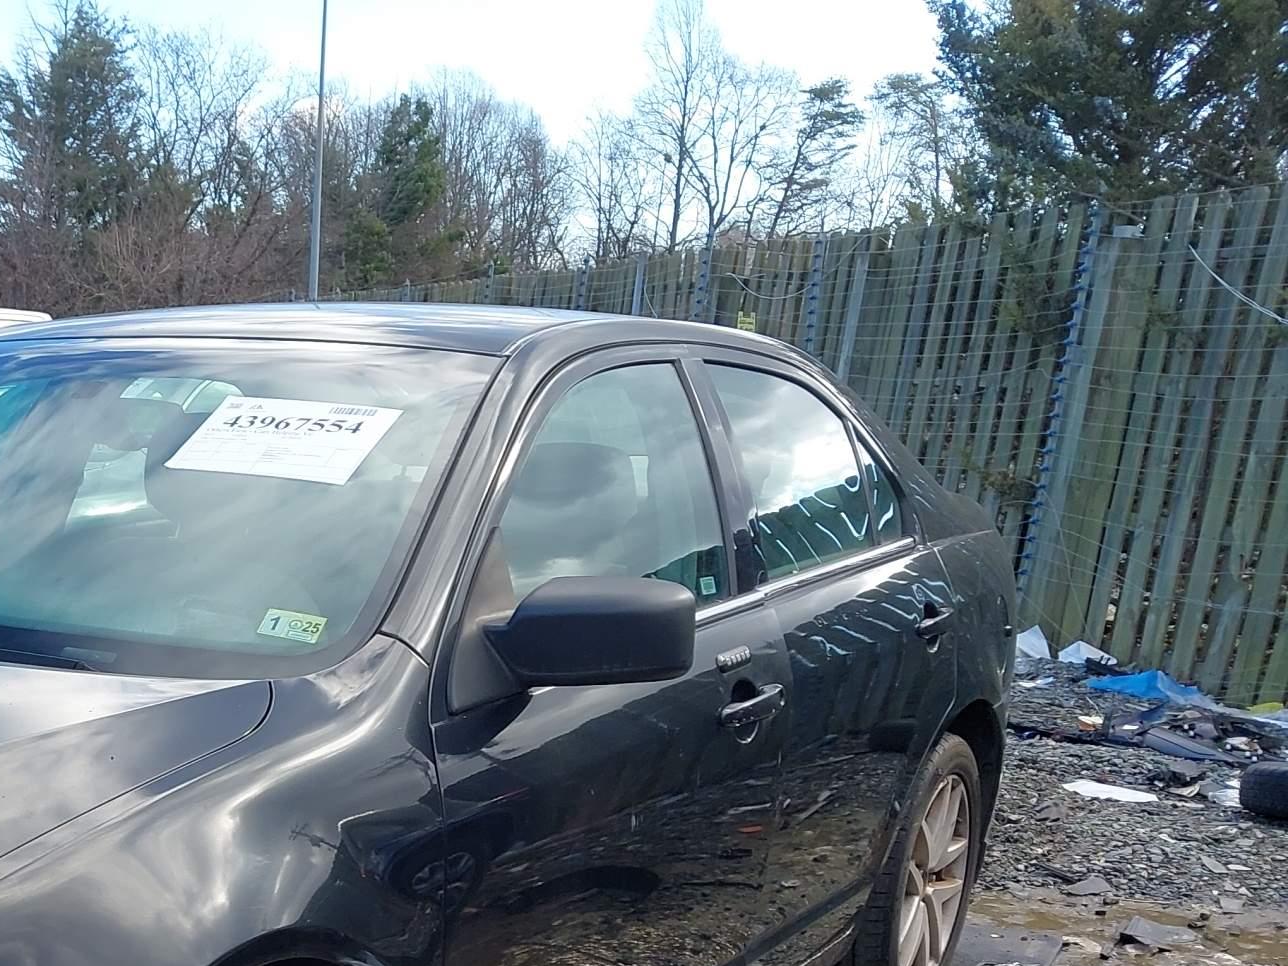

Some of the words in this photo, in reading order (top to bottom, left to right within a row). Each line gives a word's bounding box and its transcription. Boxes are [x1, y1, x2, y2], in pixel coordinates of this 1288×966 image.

[223, 414, 365, 434] 43967554
[270, 616, 281, 631] 1
[302, 621, 322, 634] 25
